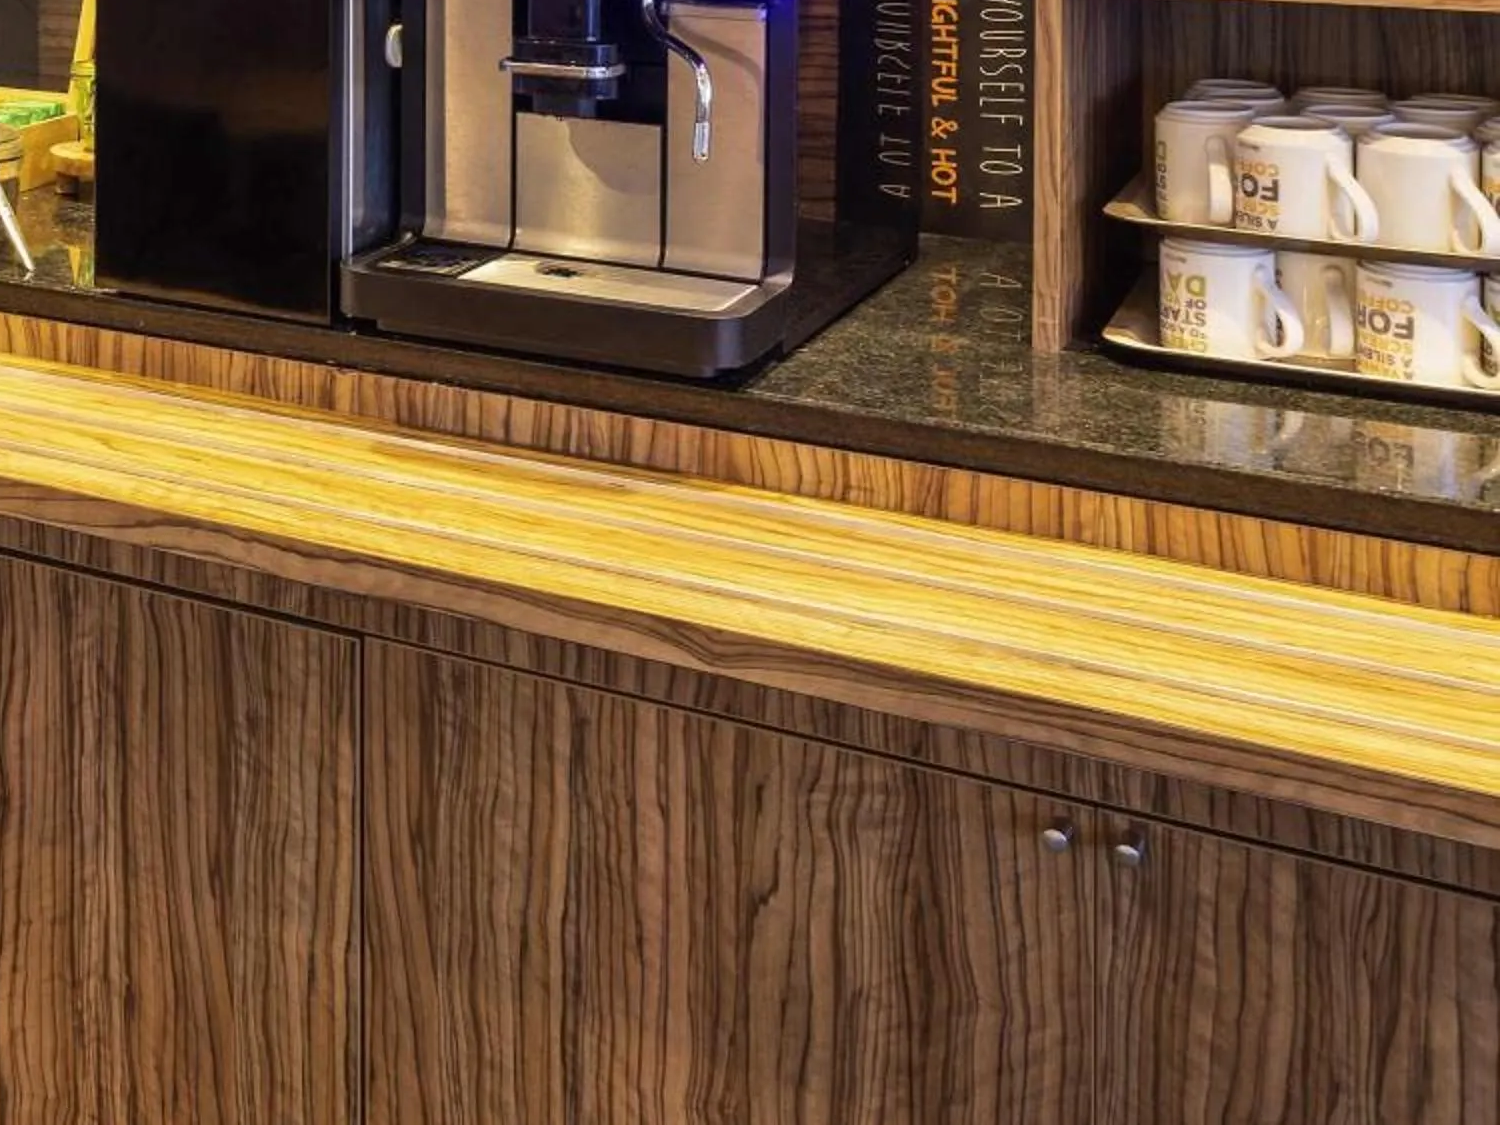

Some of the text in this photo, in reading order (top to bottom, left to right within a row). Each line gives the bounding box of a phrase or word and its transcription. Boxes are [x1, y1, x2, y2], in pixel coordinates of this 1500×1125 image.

[930, 117, 959, 140] &
[979, 142, 1025, 177] TO
[930, 147, 959, 206] HOT
[1239, 174, 1280, 204] FO
[979, 191, 1025, 211] A
